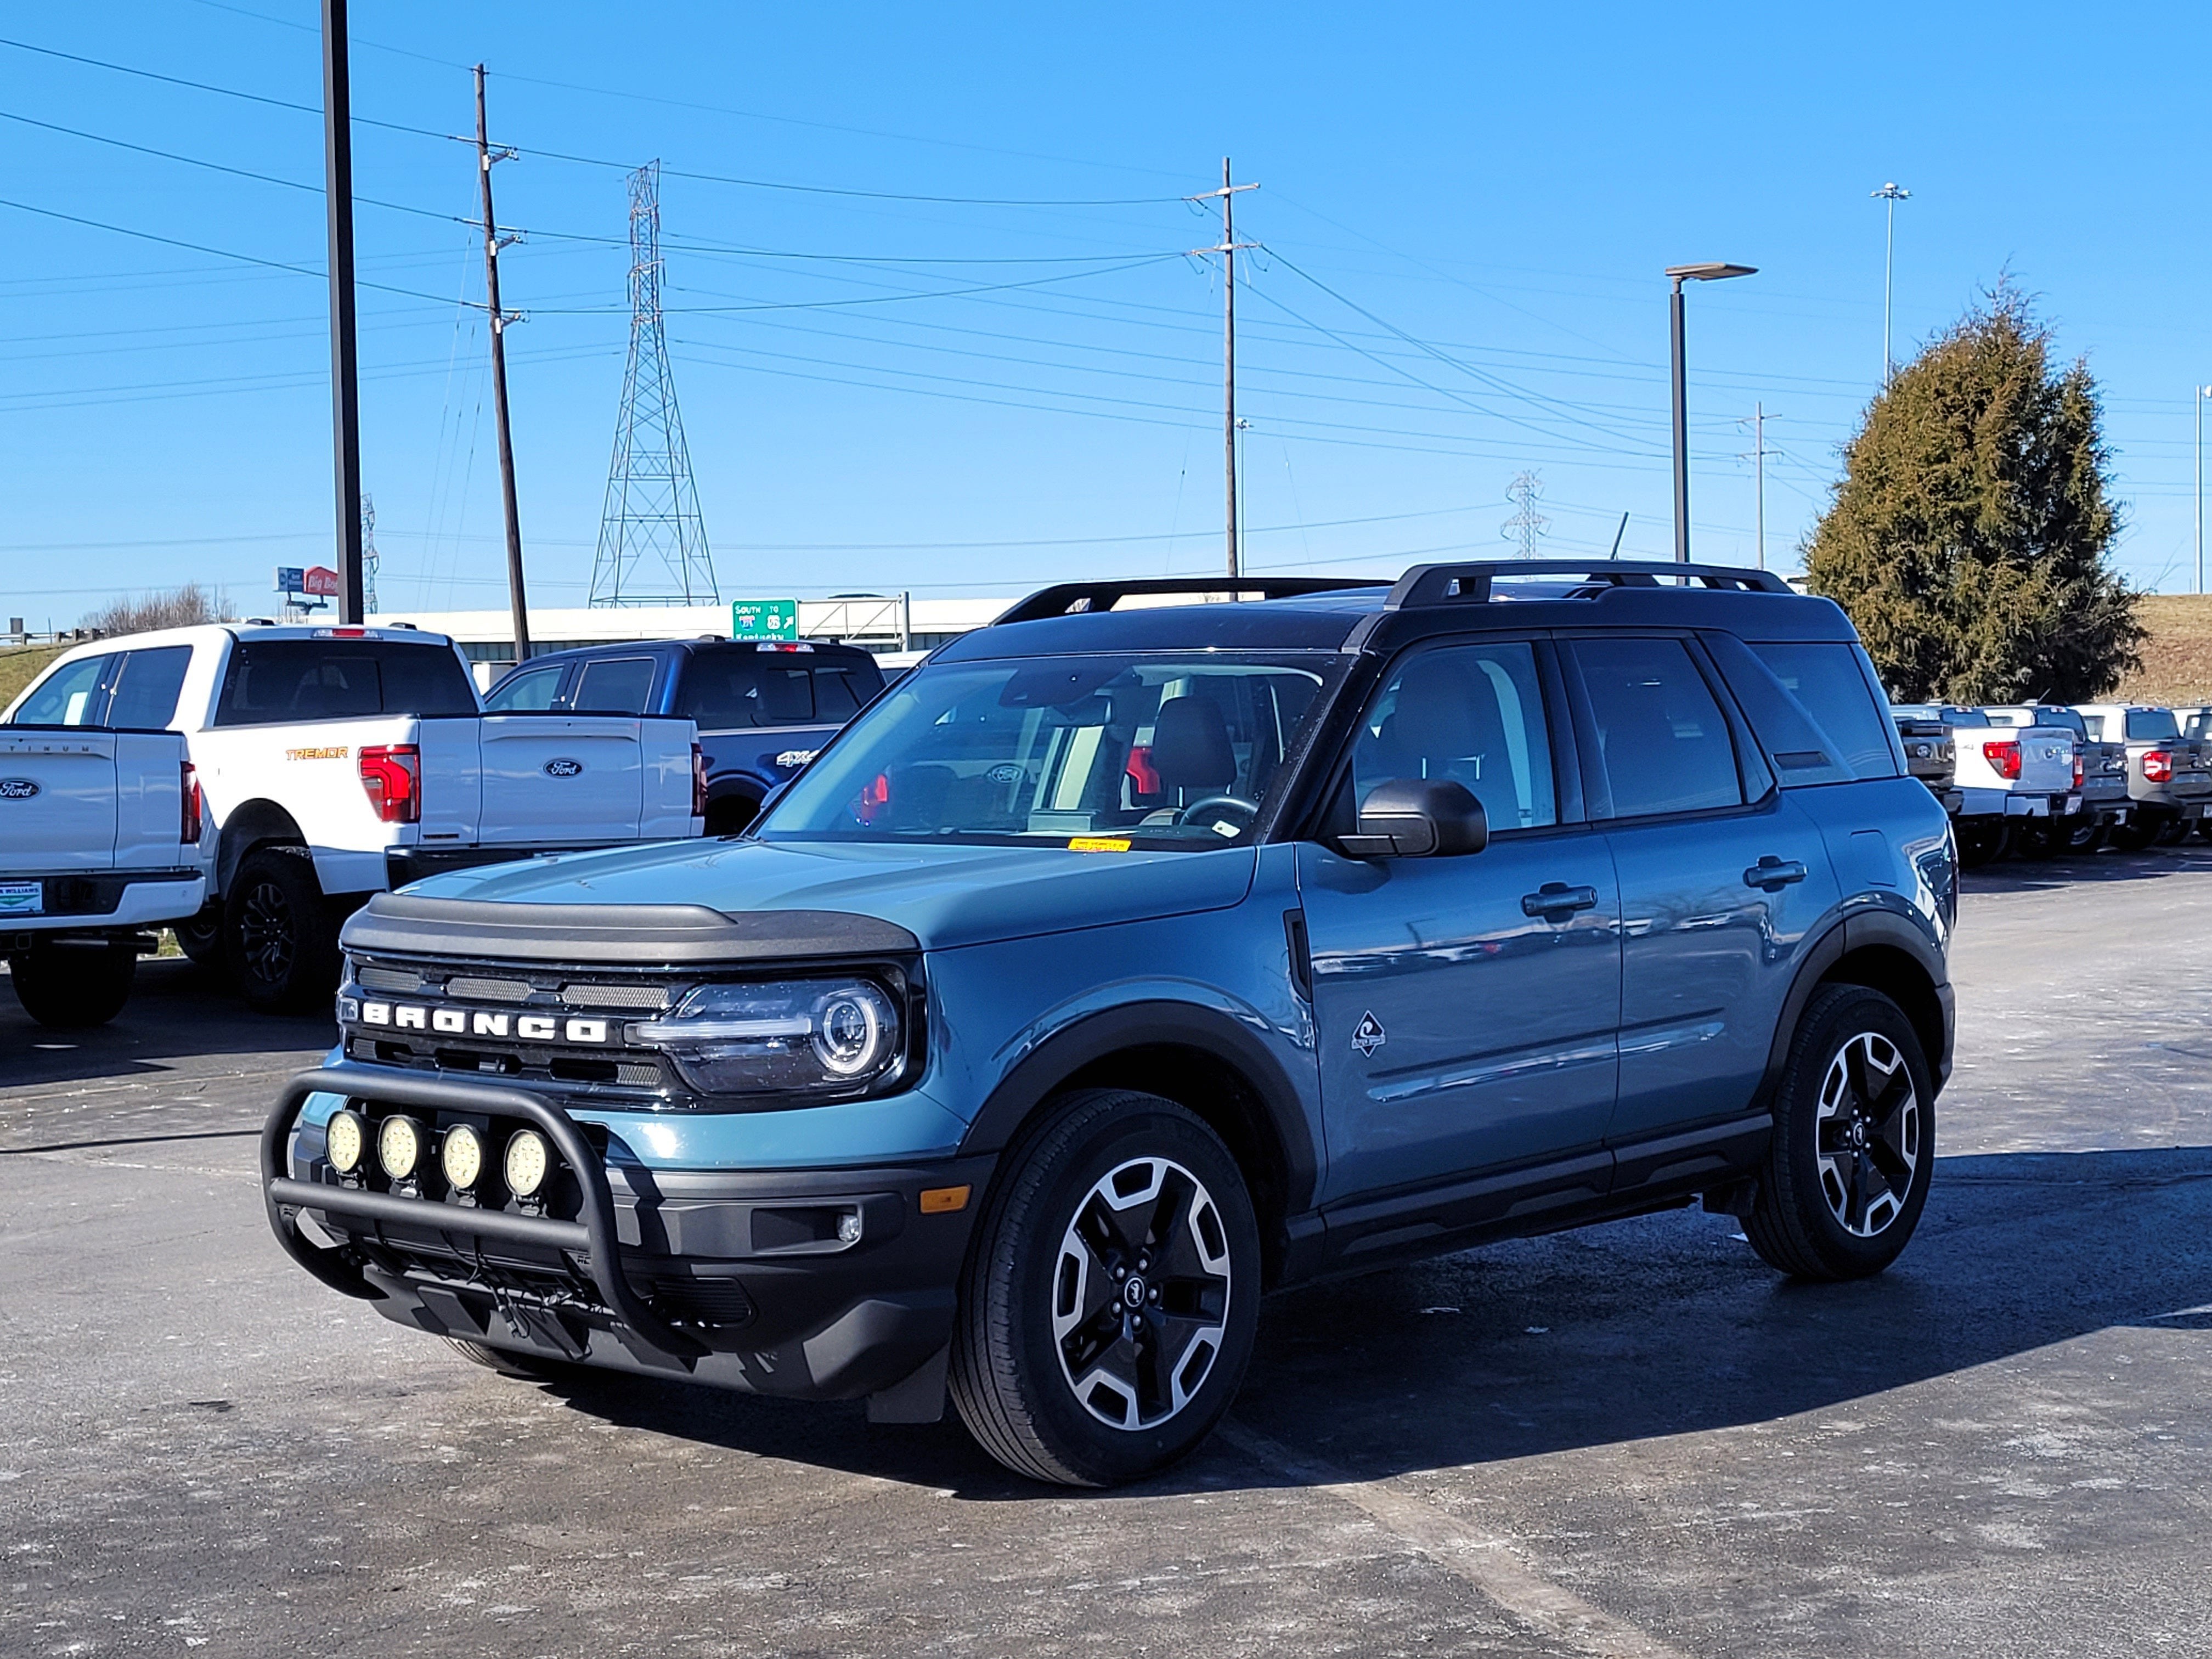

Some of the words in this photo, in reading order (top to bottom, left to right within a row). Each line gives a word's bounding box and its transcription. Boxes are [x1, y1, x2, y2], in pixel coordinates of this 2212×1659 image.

[308, 575, 323, 590] Big
[735, 605, 761, 614] SOUTH
[769, 605, 779, 613] TO
[286, 747, 348, 760] TREMOR
[551, 762, 577, 775] Ford
[0, 782, 33, 796] Ford
[363, 1001, 607, 1042] BRONCO
